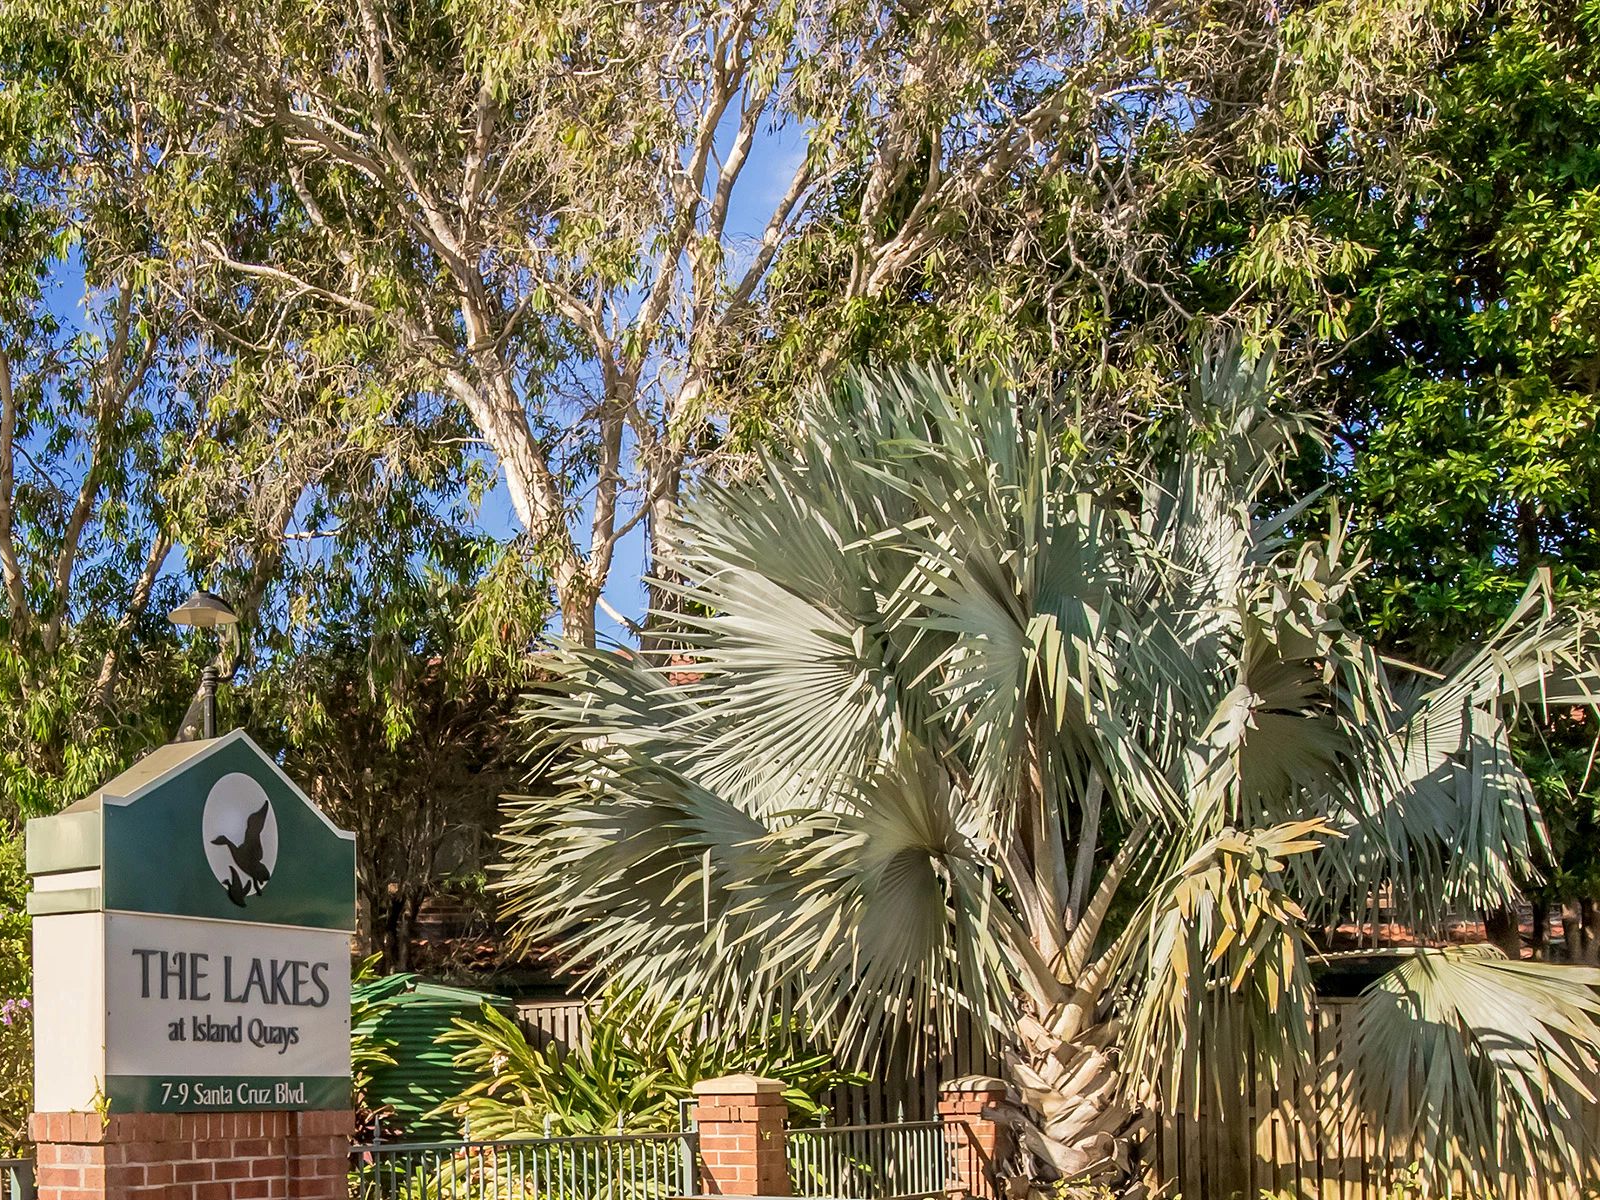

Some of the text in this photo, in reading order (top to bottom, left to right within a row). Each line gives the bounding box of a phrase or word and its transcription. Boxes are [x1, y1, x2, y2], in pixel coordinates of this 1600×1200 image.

[132, 948, 330, 1008] THE LAKES
[168, 1014, 300, 1054] at Island Quays
[161, 1081, 308, 1106] 7-9 Santa Cruz Blvd.
